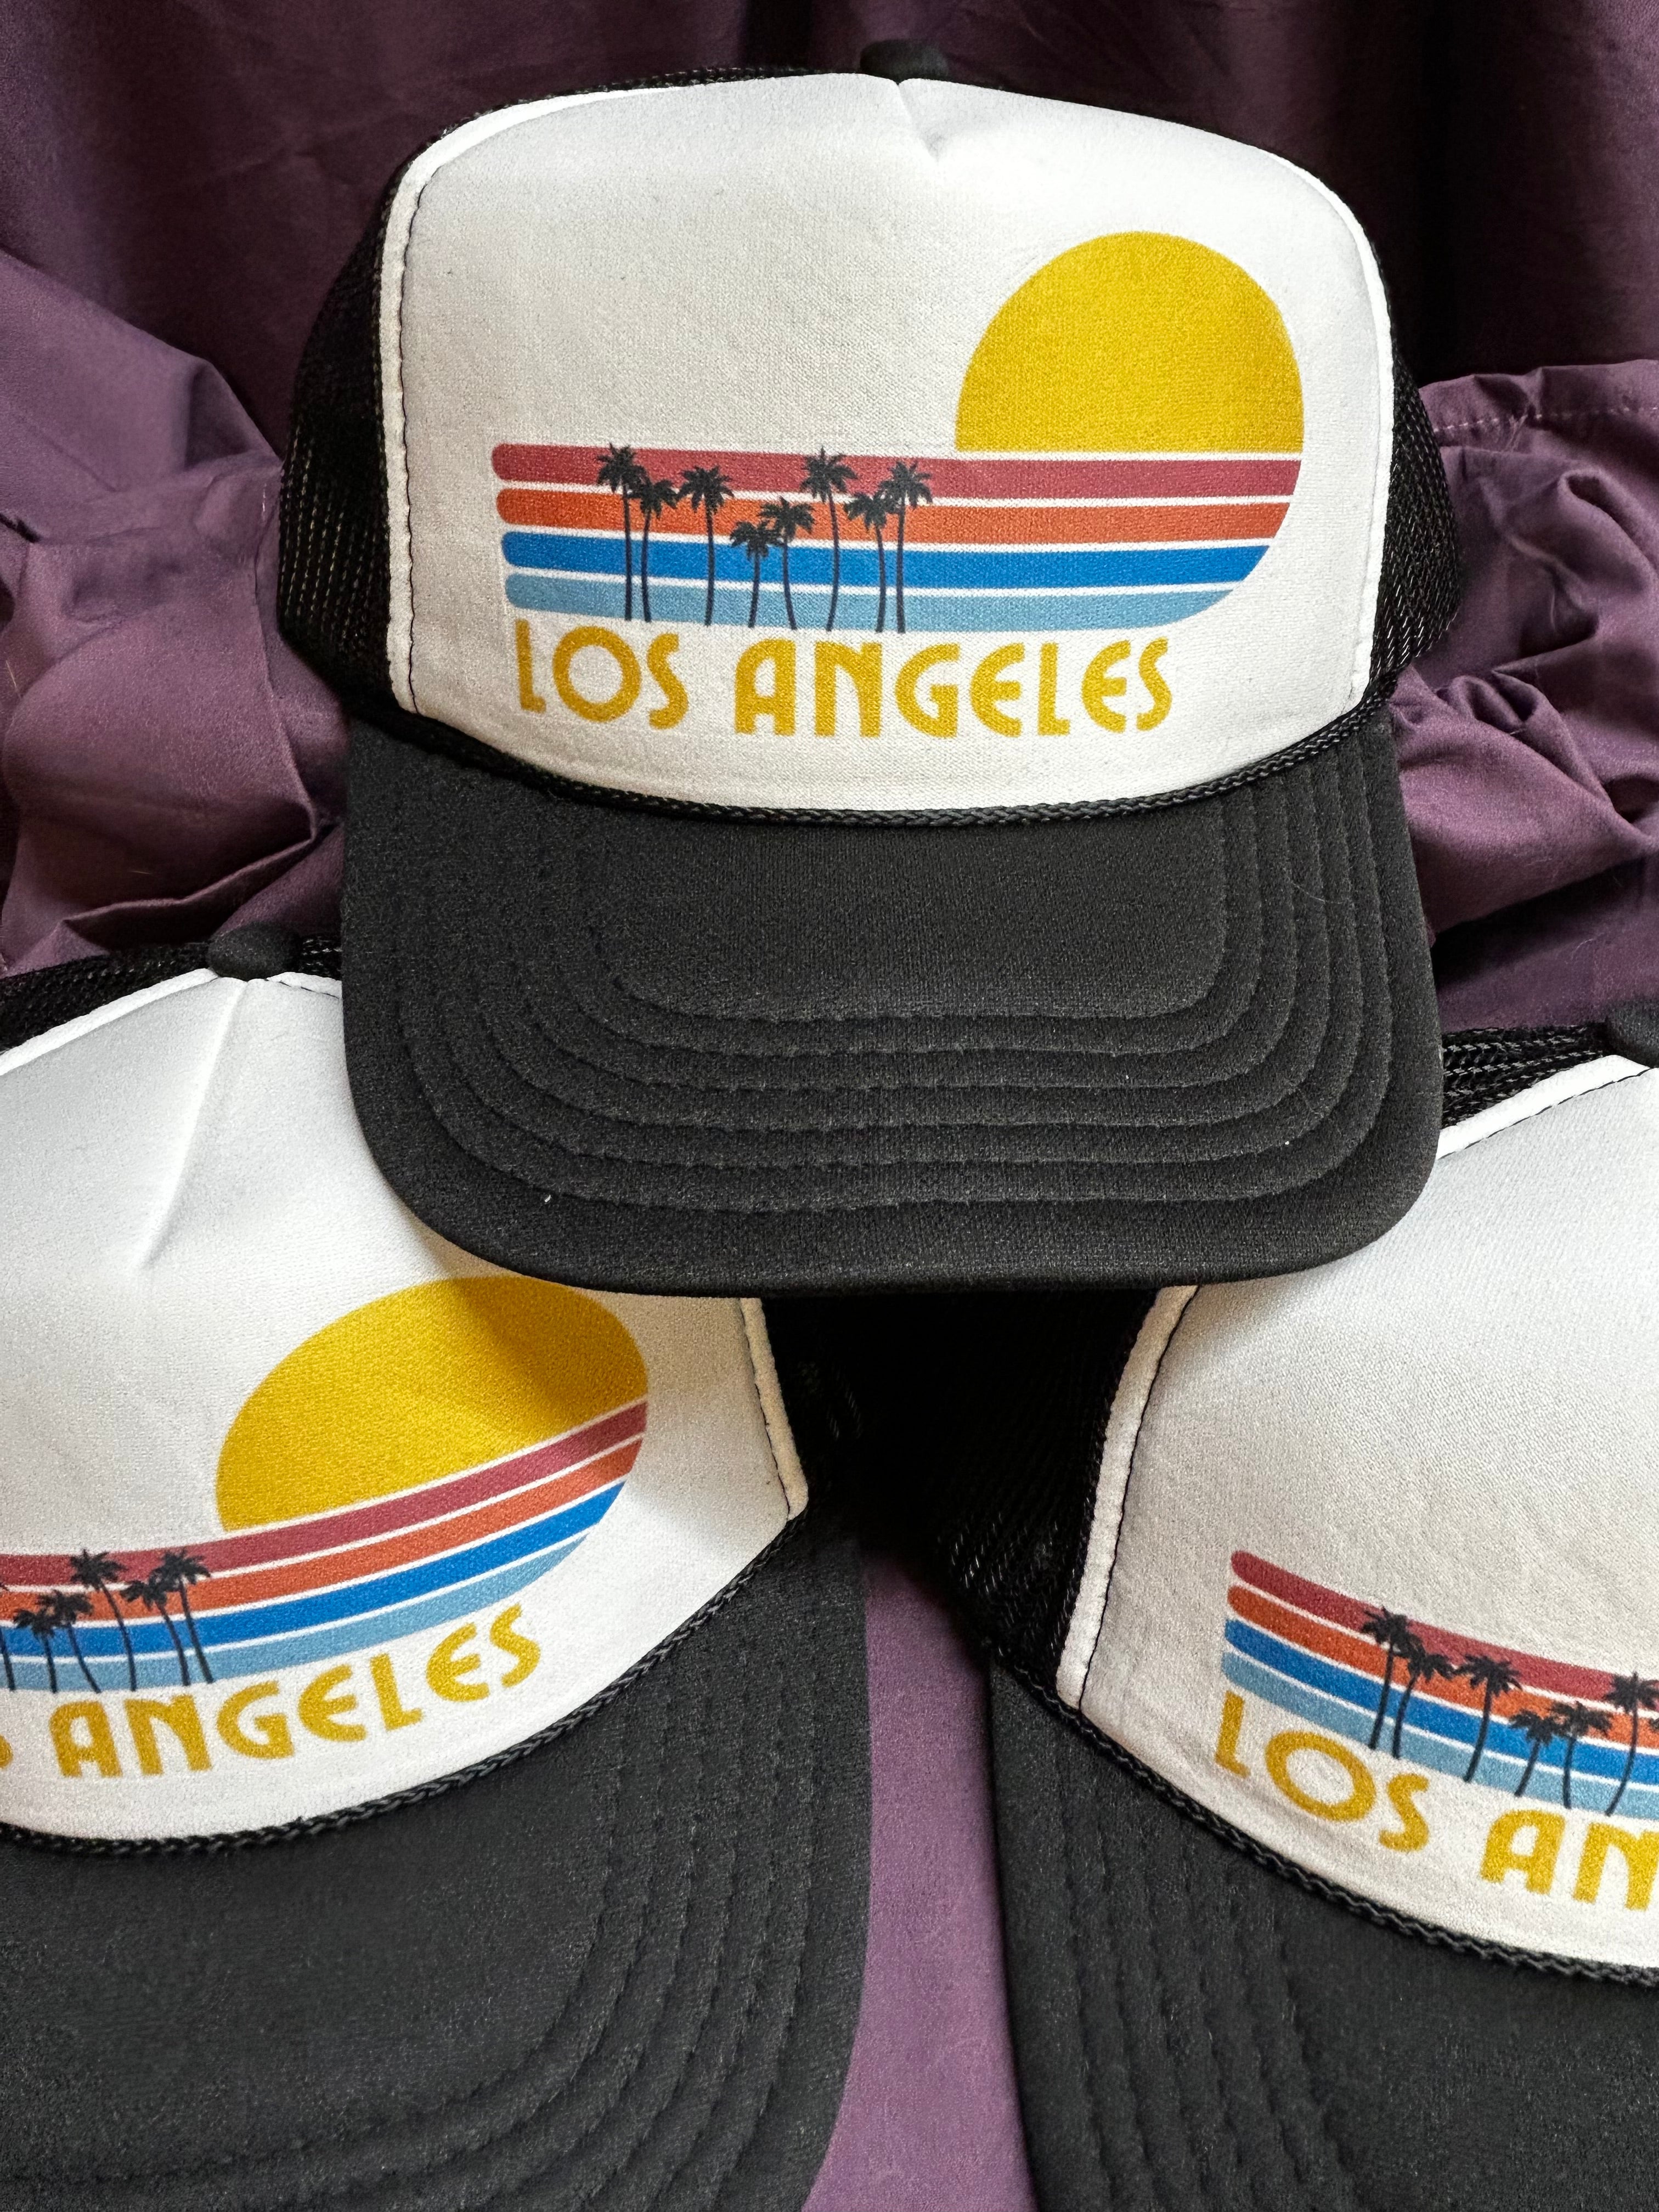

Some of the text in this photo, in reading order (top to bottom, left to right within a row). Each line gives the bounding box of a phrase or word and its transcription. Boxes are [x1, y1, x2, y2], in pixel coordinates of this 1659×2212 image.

[515, 619, 1172, 738] LOS ANGELES
[49, 1604, 540, 1778] ANGELES
[1215, 1690, 1430, 1853] LOS
